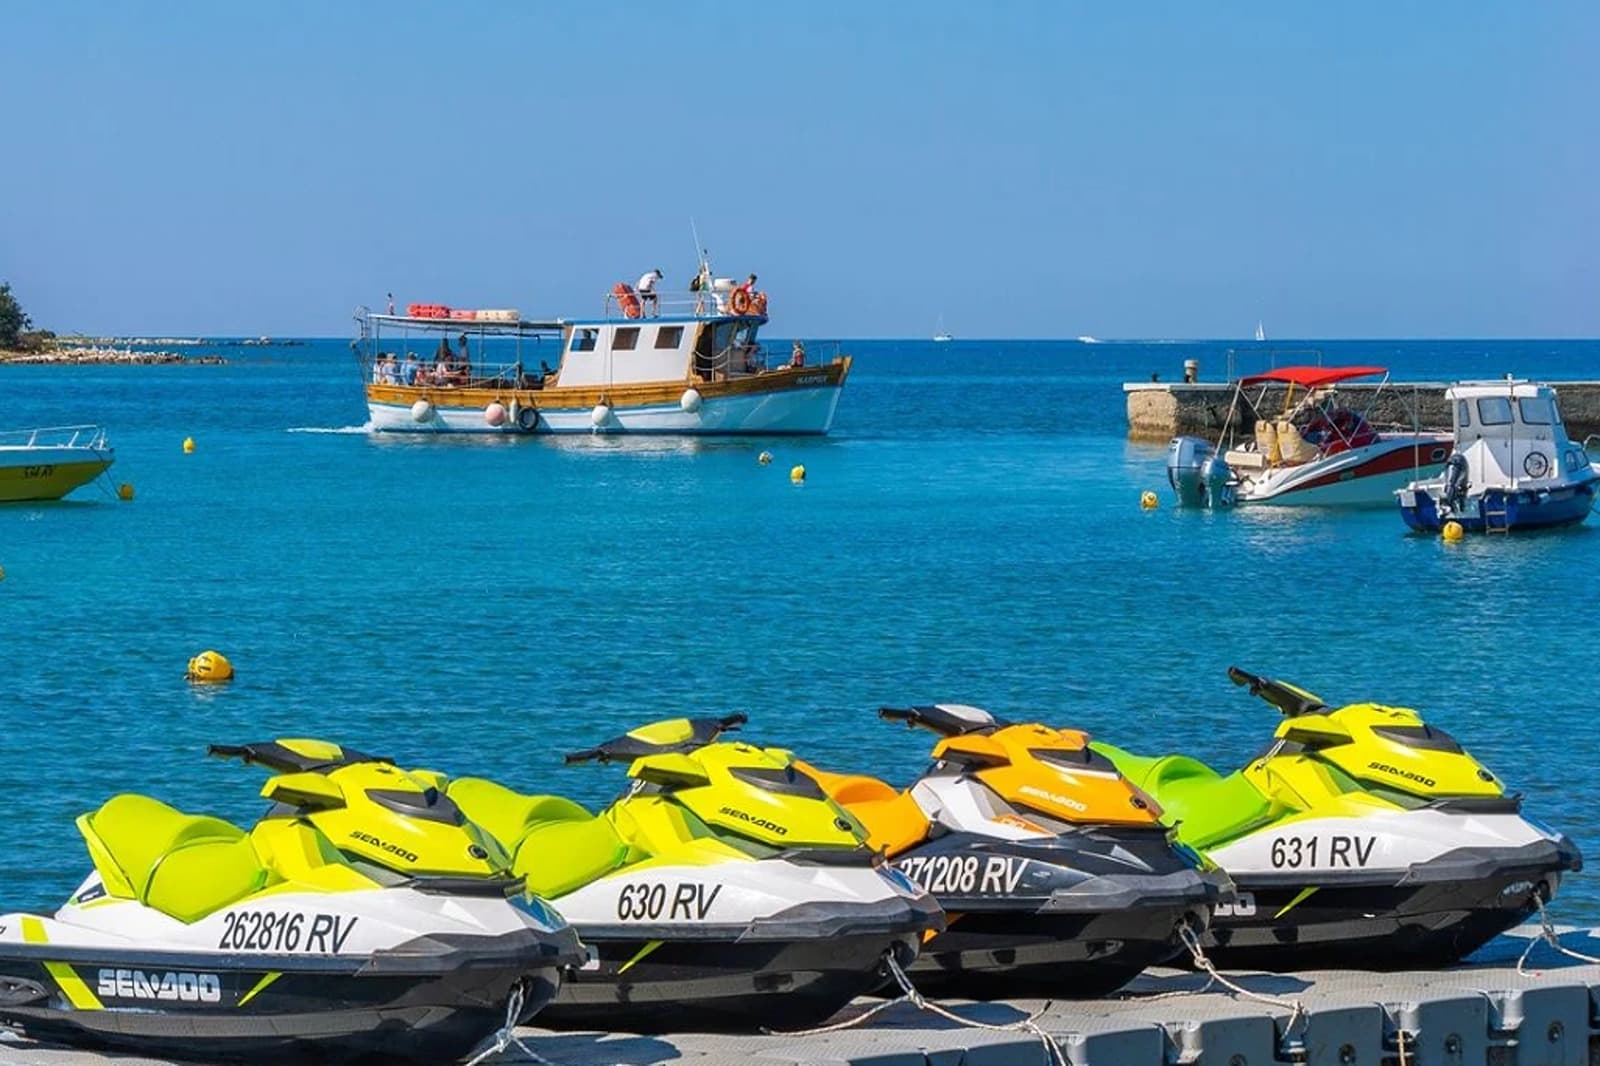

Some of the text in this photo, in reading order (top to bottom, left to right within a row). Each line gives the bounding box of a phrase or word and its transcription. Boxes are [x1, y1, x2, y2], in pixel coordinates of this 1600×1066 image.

[1271, 836, 1377, 868] 631 RV
[980, 857, 1029, 892] RV
[618, 883, 722, 920] 630 RV
[219, 912, 358, 953] 262816 RV
